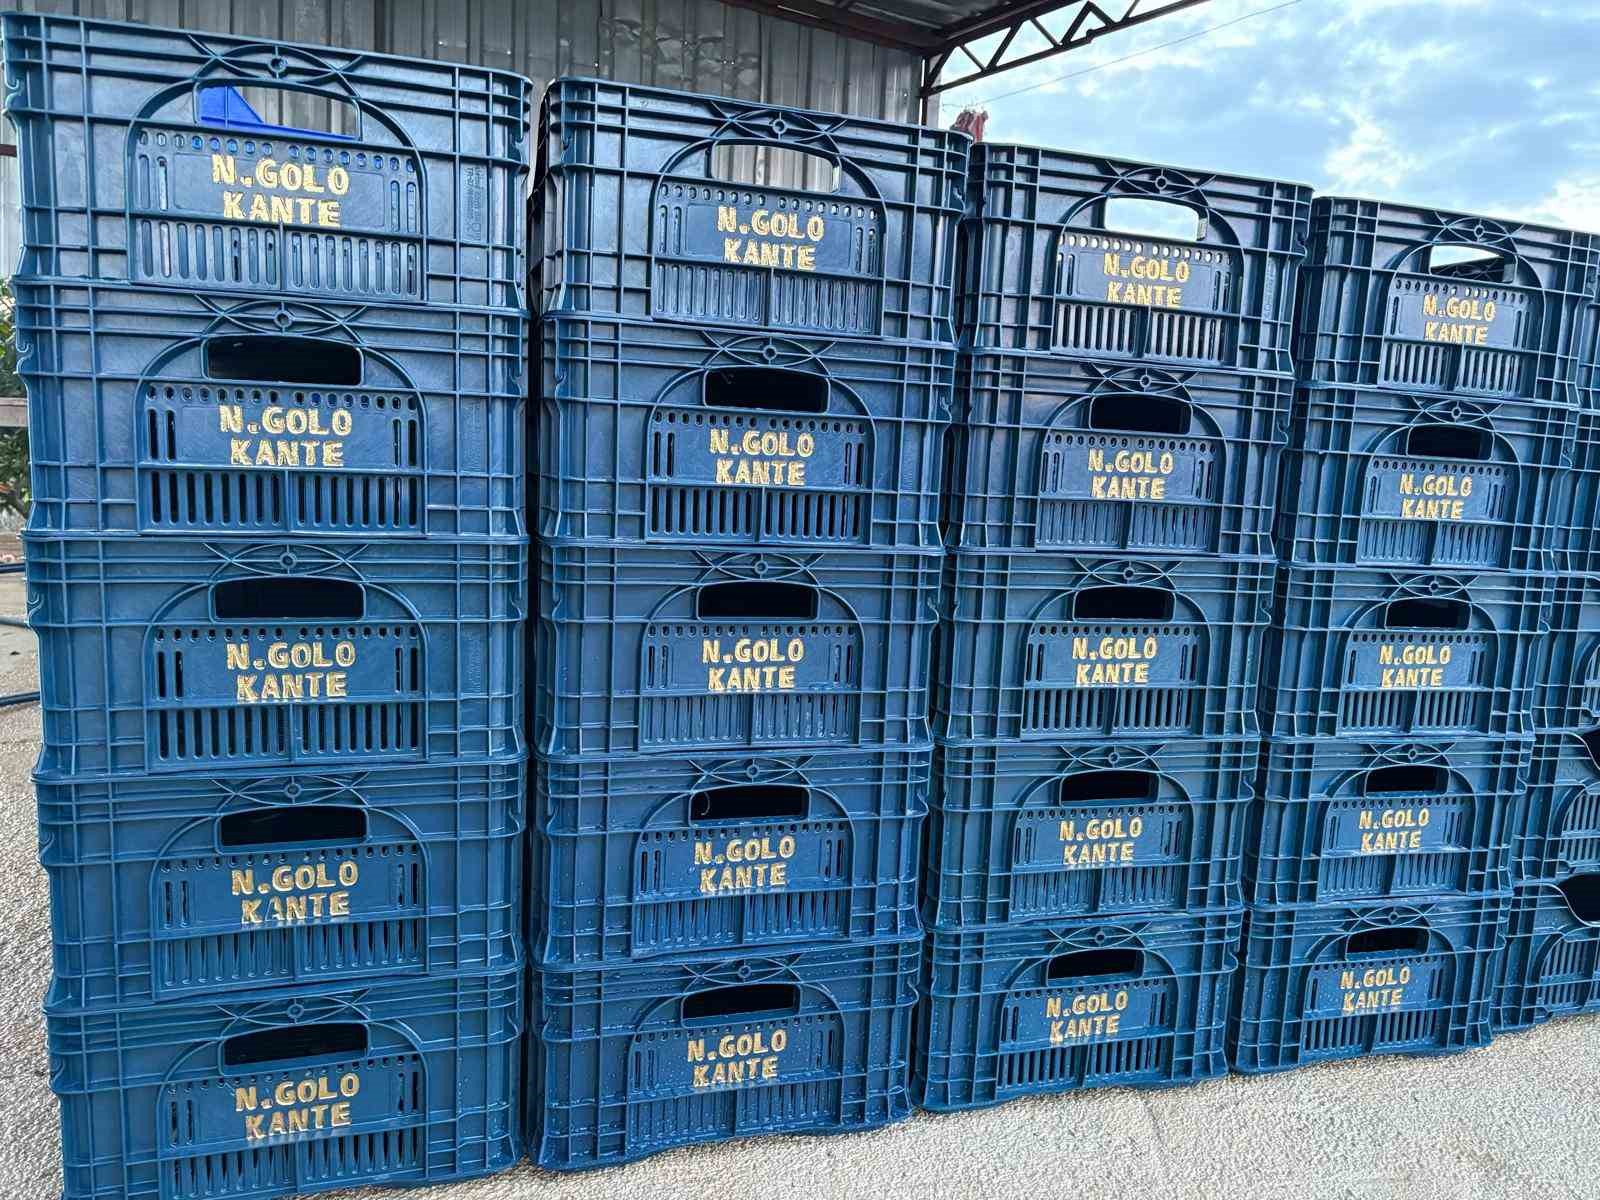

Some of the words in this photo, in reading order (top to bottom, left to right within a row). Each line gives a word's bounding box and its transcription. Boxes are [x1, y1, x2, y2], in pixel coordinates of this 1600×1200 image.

[213, 155, 350, 196] N.GOLO
[222, 191, 341, 227] KANTE
[716, 206, 825, 241] N.GOLO
[725, 239, 816, 271] KANTE
[1104, 252, 1191, 282] N.GOLO
[1106, 281, 1181, 307] KANTE
[1424, 295, 1495, 321] N.GOLO
[1426, 320, 1487, 345] KANTE
[219, 405, 352, 436] N.GOLO
[230, 437, 343, 467] KANTE
[711, 430, 814, 457] N.GOLO
[717, 460, 805, 487] KANTE
[1088, 449, 1174, 474] N.GOLO
[1093, 476, 1164, 500] KANTE
[1401, 475, 1472, 497] N.GOLO
[1403, 499, 1463, 520] KANTE
[226, 641, 356, 670] N.GOLO
[702, 638, 805, 663] N.GOLO
[1072, 636, 1157, 660] N.GOLO
[1379, 645, 1451, 664] N.GOLO
[236, 671, 347, 702] KANTE
[708, 664, 796, 694] KANTE
[1075, 663, 1149, 687] KANTE
[1381, 668, 1443, 690] KANTE
[1059, 816, 1142, 841] N.GOLO
[1359, 809, 1430, 829] N.GOLO
[694, 836, 795, 865] N.GOLO
[1063, 843, 1133, 865] KANTE
[1361, 830, 1421, 853] KANTE
[231, 861, 358, 895] N.GOLO
[700, 863, 785, 892] KANTE
[241, 891, 349, 925] KANTE
[1340, 967, 1411, 989] N.GOLO
[1046, 991, 1128, 1017] N.GOLO
[1343, 988, 1403, 1013] KANTE
[1051, 1015, 1121, 1045] KANTE
[687, 1029, 788, 1061] N.GOLO
[693, 1055, 777, 1089] KANTE
[235, 1073, 360, 1111] N.GOLO
[245, 1101, 352, 1140] KANTE
